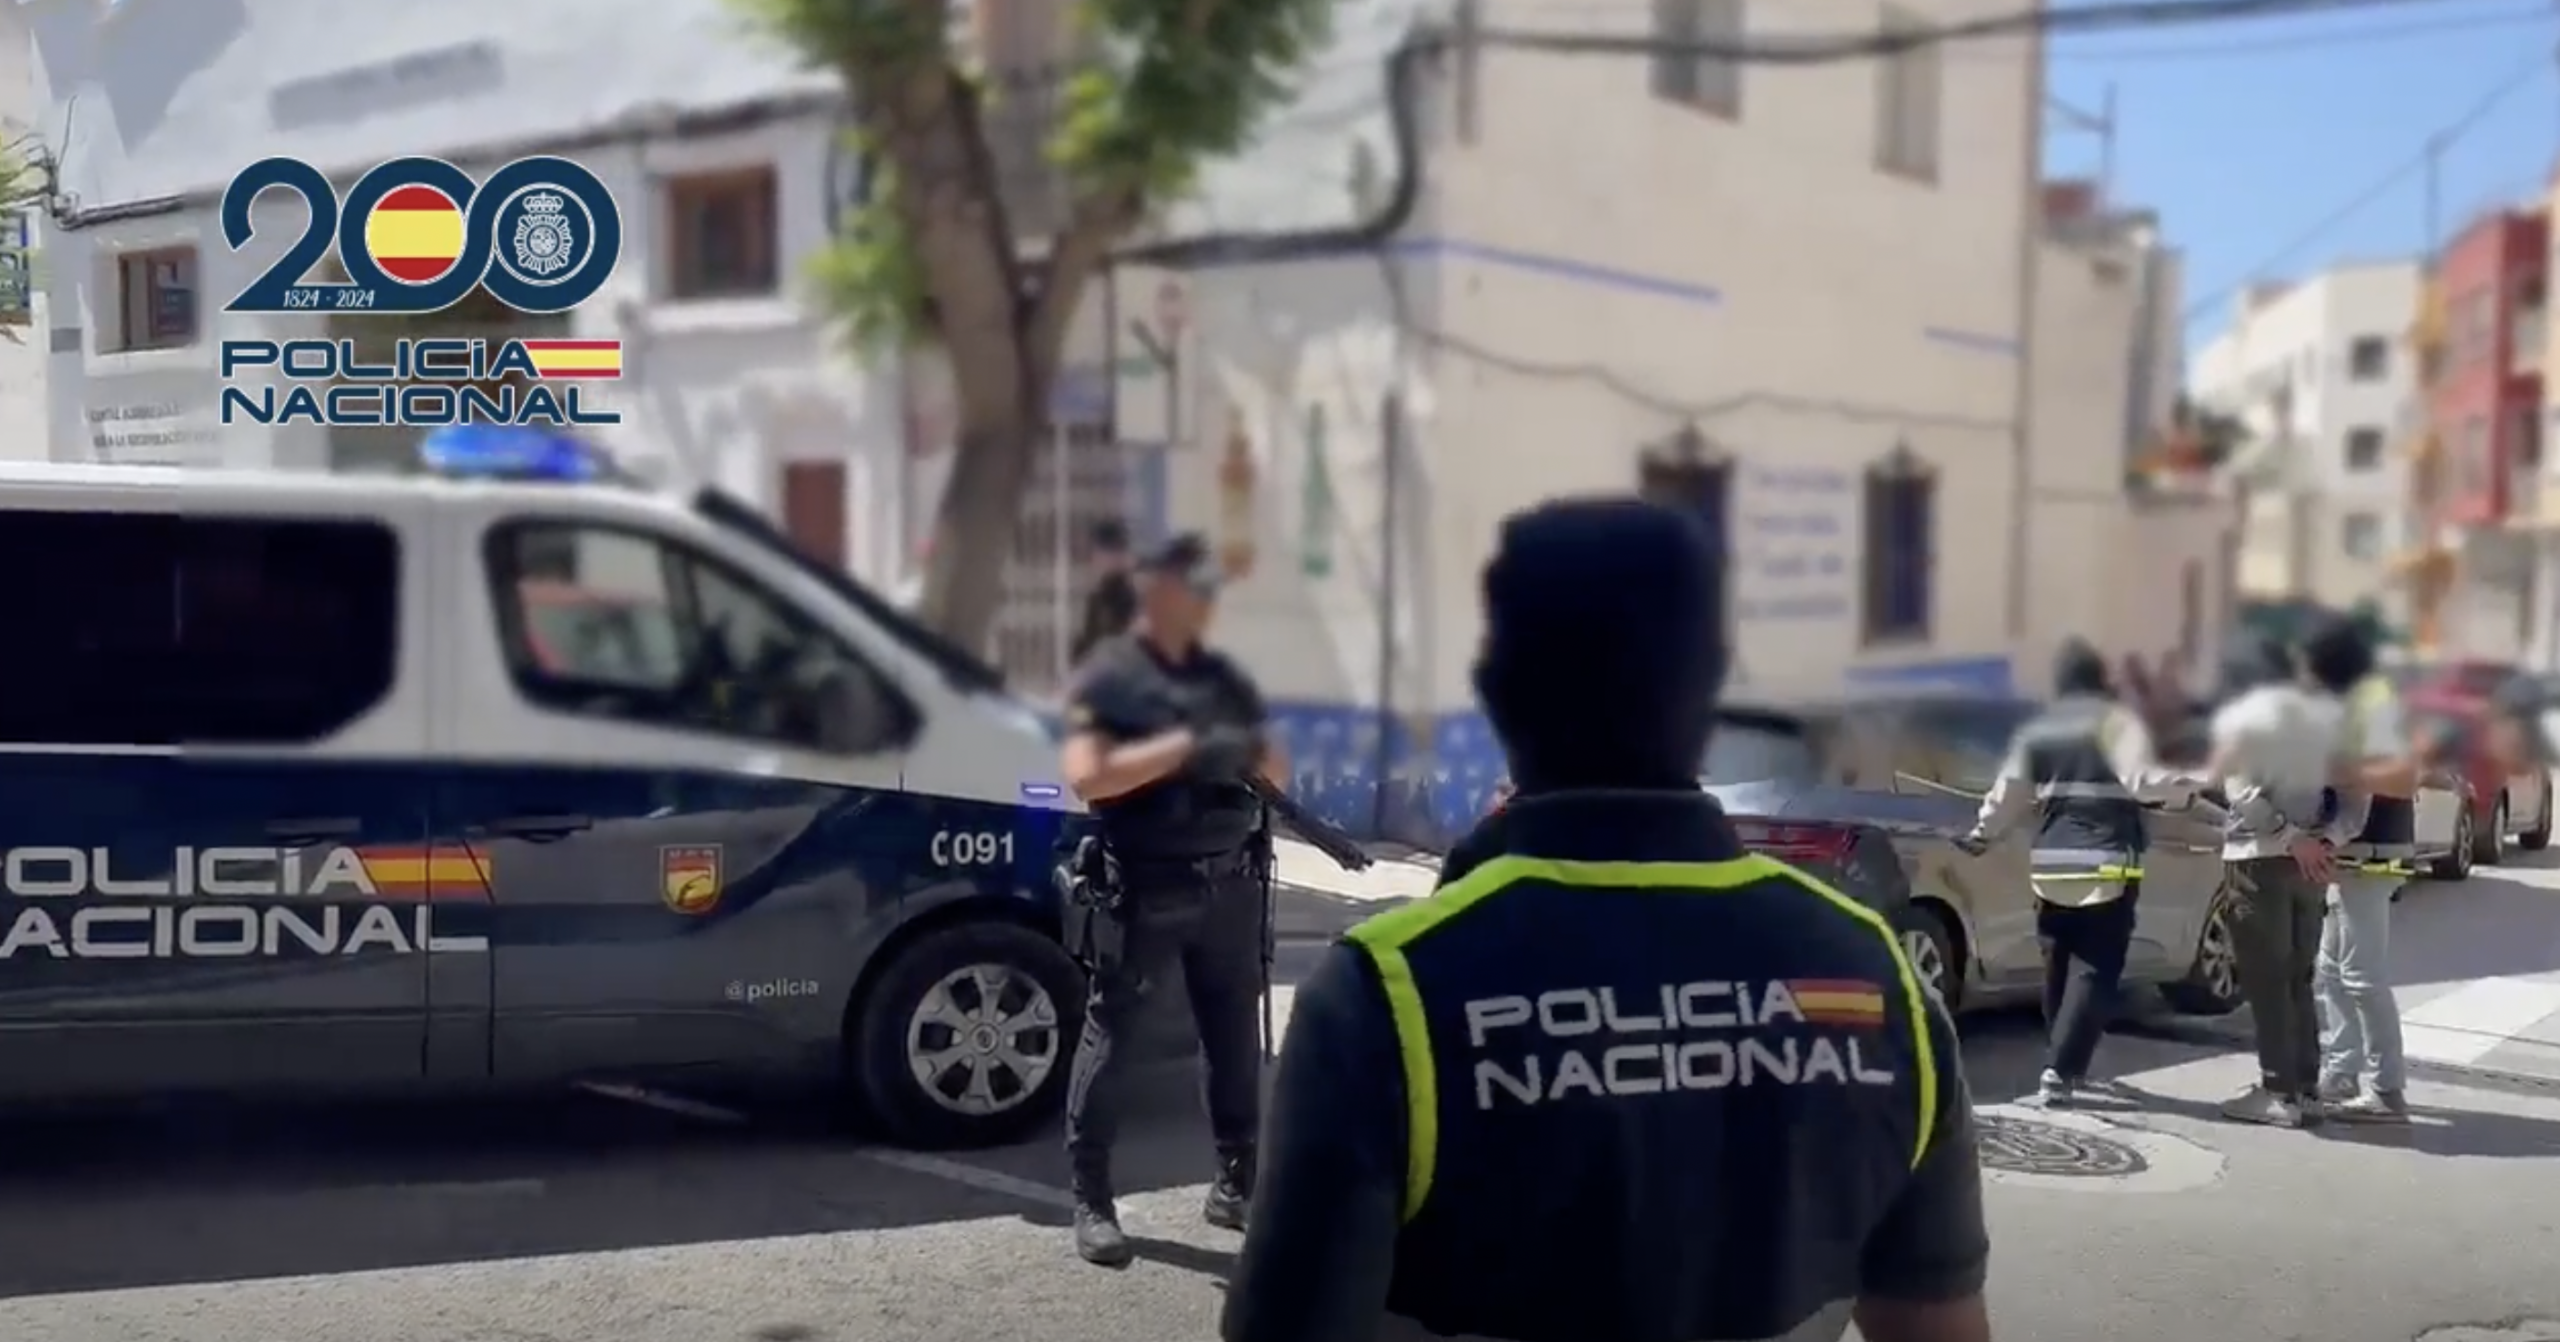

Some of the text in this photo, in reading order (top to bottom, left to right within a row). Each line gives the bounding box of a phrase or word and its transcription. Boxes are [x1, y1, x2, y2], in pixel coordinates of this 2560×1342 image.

[0, 845, 379, 896] OLICÍA
[0, 903, 489, 958] ACIONAL
[1473, 1036, 1895, 1110] NACIONAL
